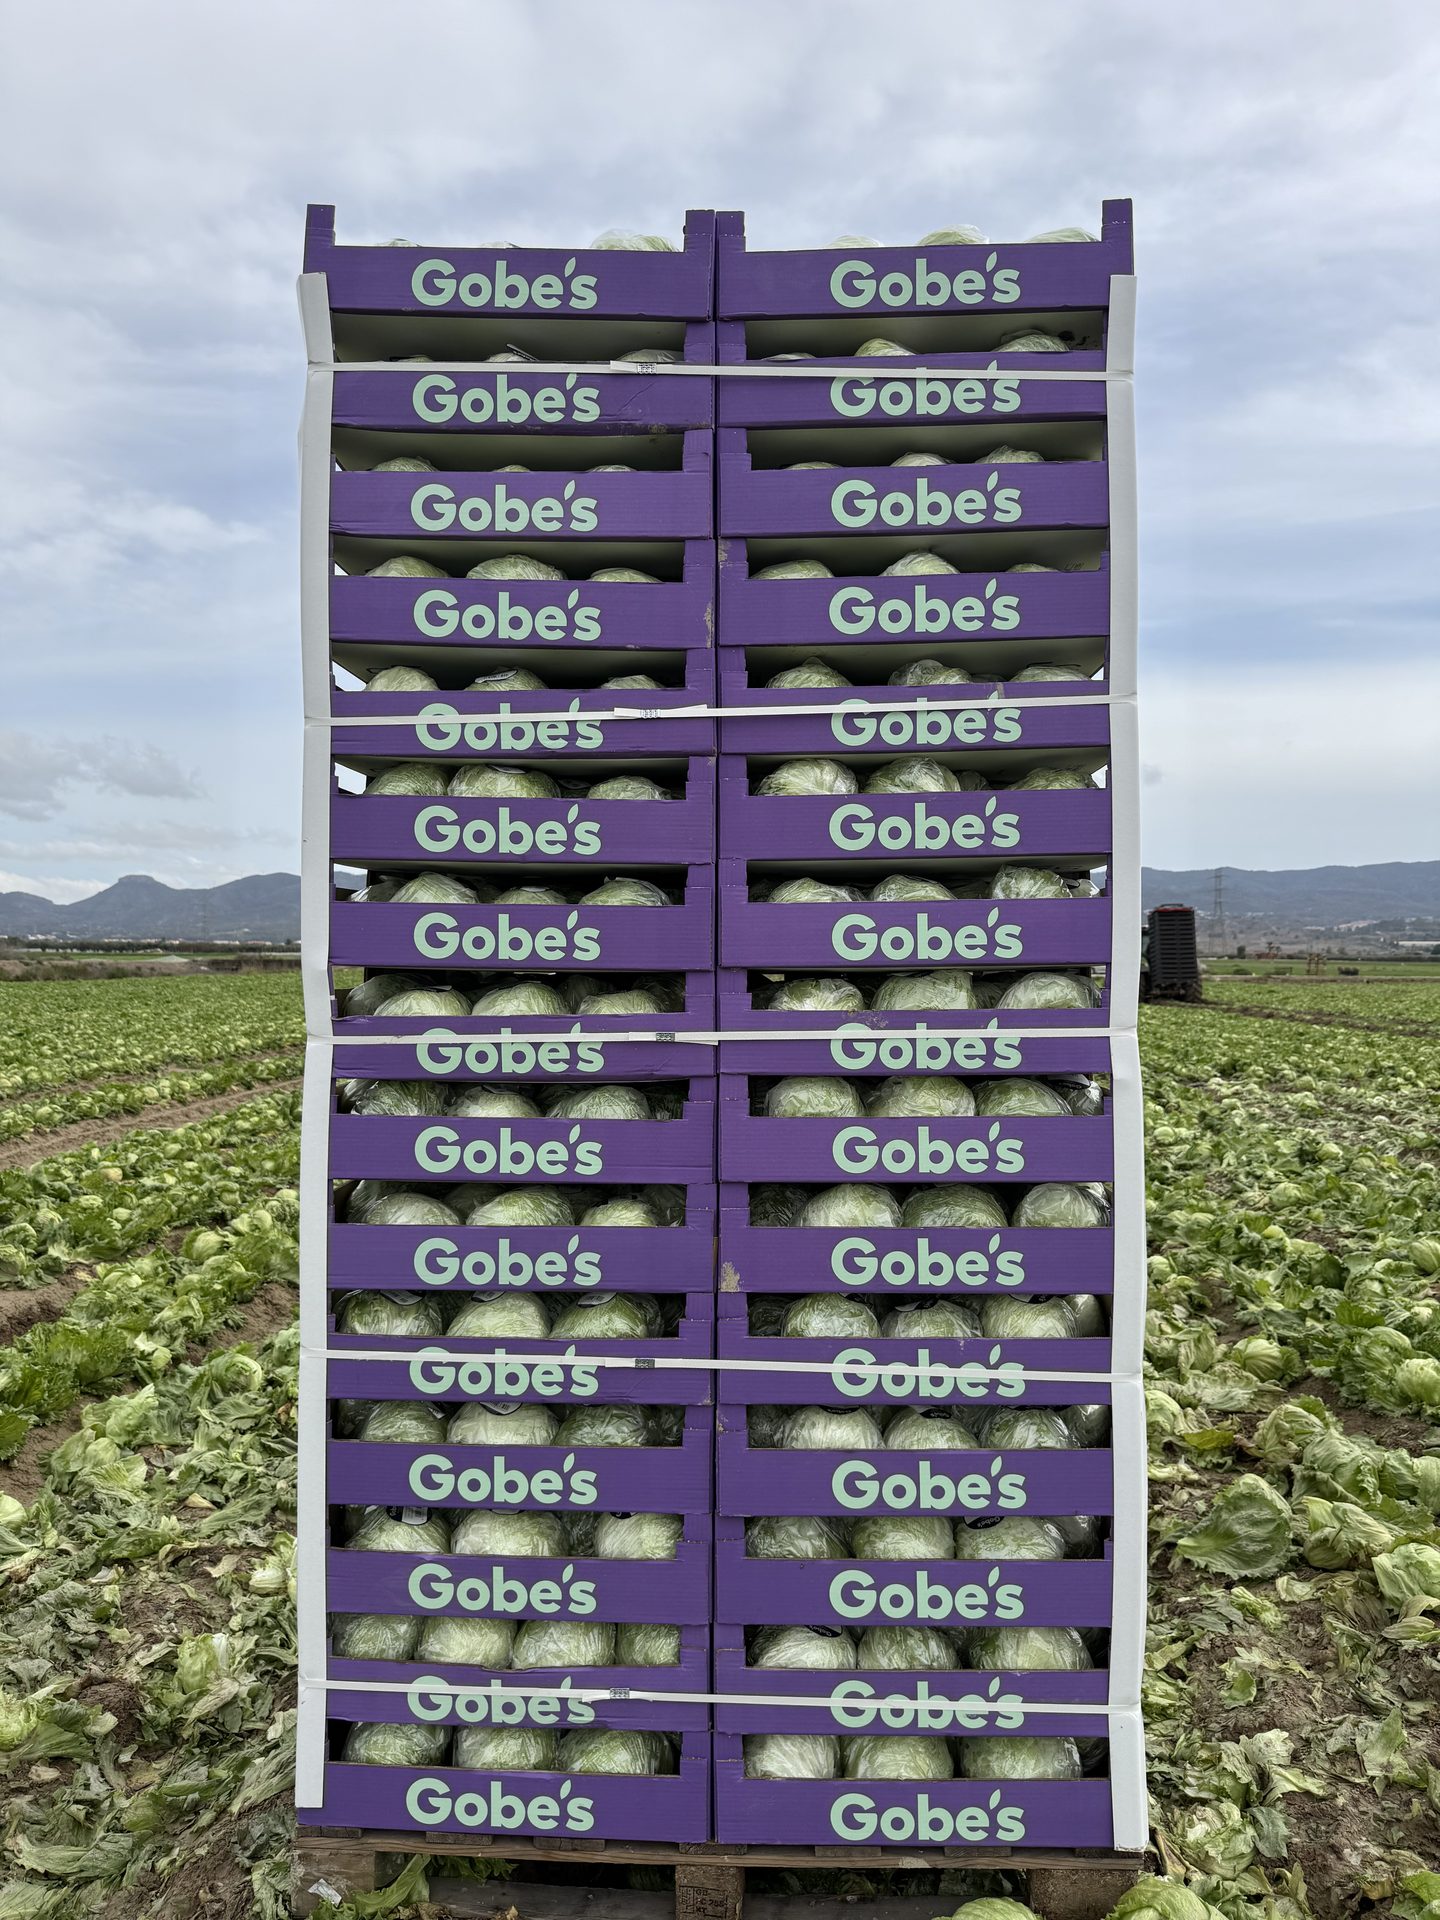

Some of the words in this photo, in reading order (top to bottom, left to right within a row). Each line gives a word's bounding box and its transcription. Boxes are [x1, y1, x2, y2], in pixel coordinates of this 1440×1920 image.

[411, 259, 597, 308] Gobe's
[830, 252, 1021, 308] Gobe's
[411, 480, 597, 532] Gobe's
[831, 471, 1021, 527] Gobe's
[413, 588, 601, 641] Gobe's
[829, 579, 1020, 635] Gobe's
[414, 804, 601, 855] Gobe's
[829, 797, 1020, 851] Gobe's
[413, 910, 600, 961] Gobe's
[831, 907, 1023, 961] Gobe's
[415, 1124, 603, 1175] Gobe's
[832, 1122, 1025, 1174] Gobe's
[414, 1235, 601, 1287] Gobe's
[831, 1234, 1025, 1286] Gobe's
[408, 1452, 598, 1505] Gobe's
[831, 1455, 1027, 1510] Gobe's
[408, 1562, 597, 1615] Gobe's
[829, 1566, 1024, 1620] Gobe's
[406, 1776, 594, 1831] Gobe's
[830, 1789, 1025, 1842] Gobe's
